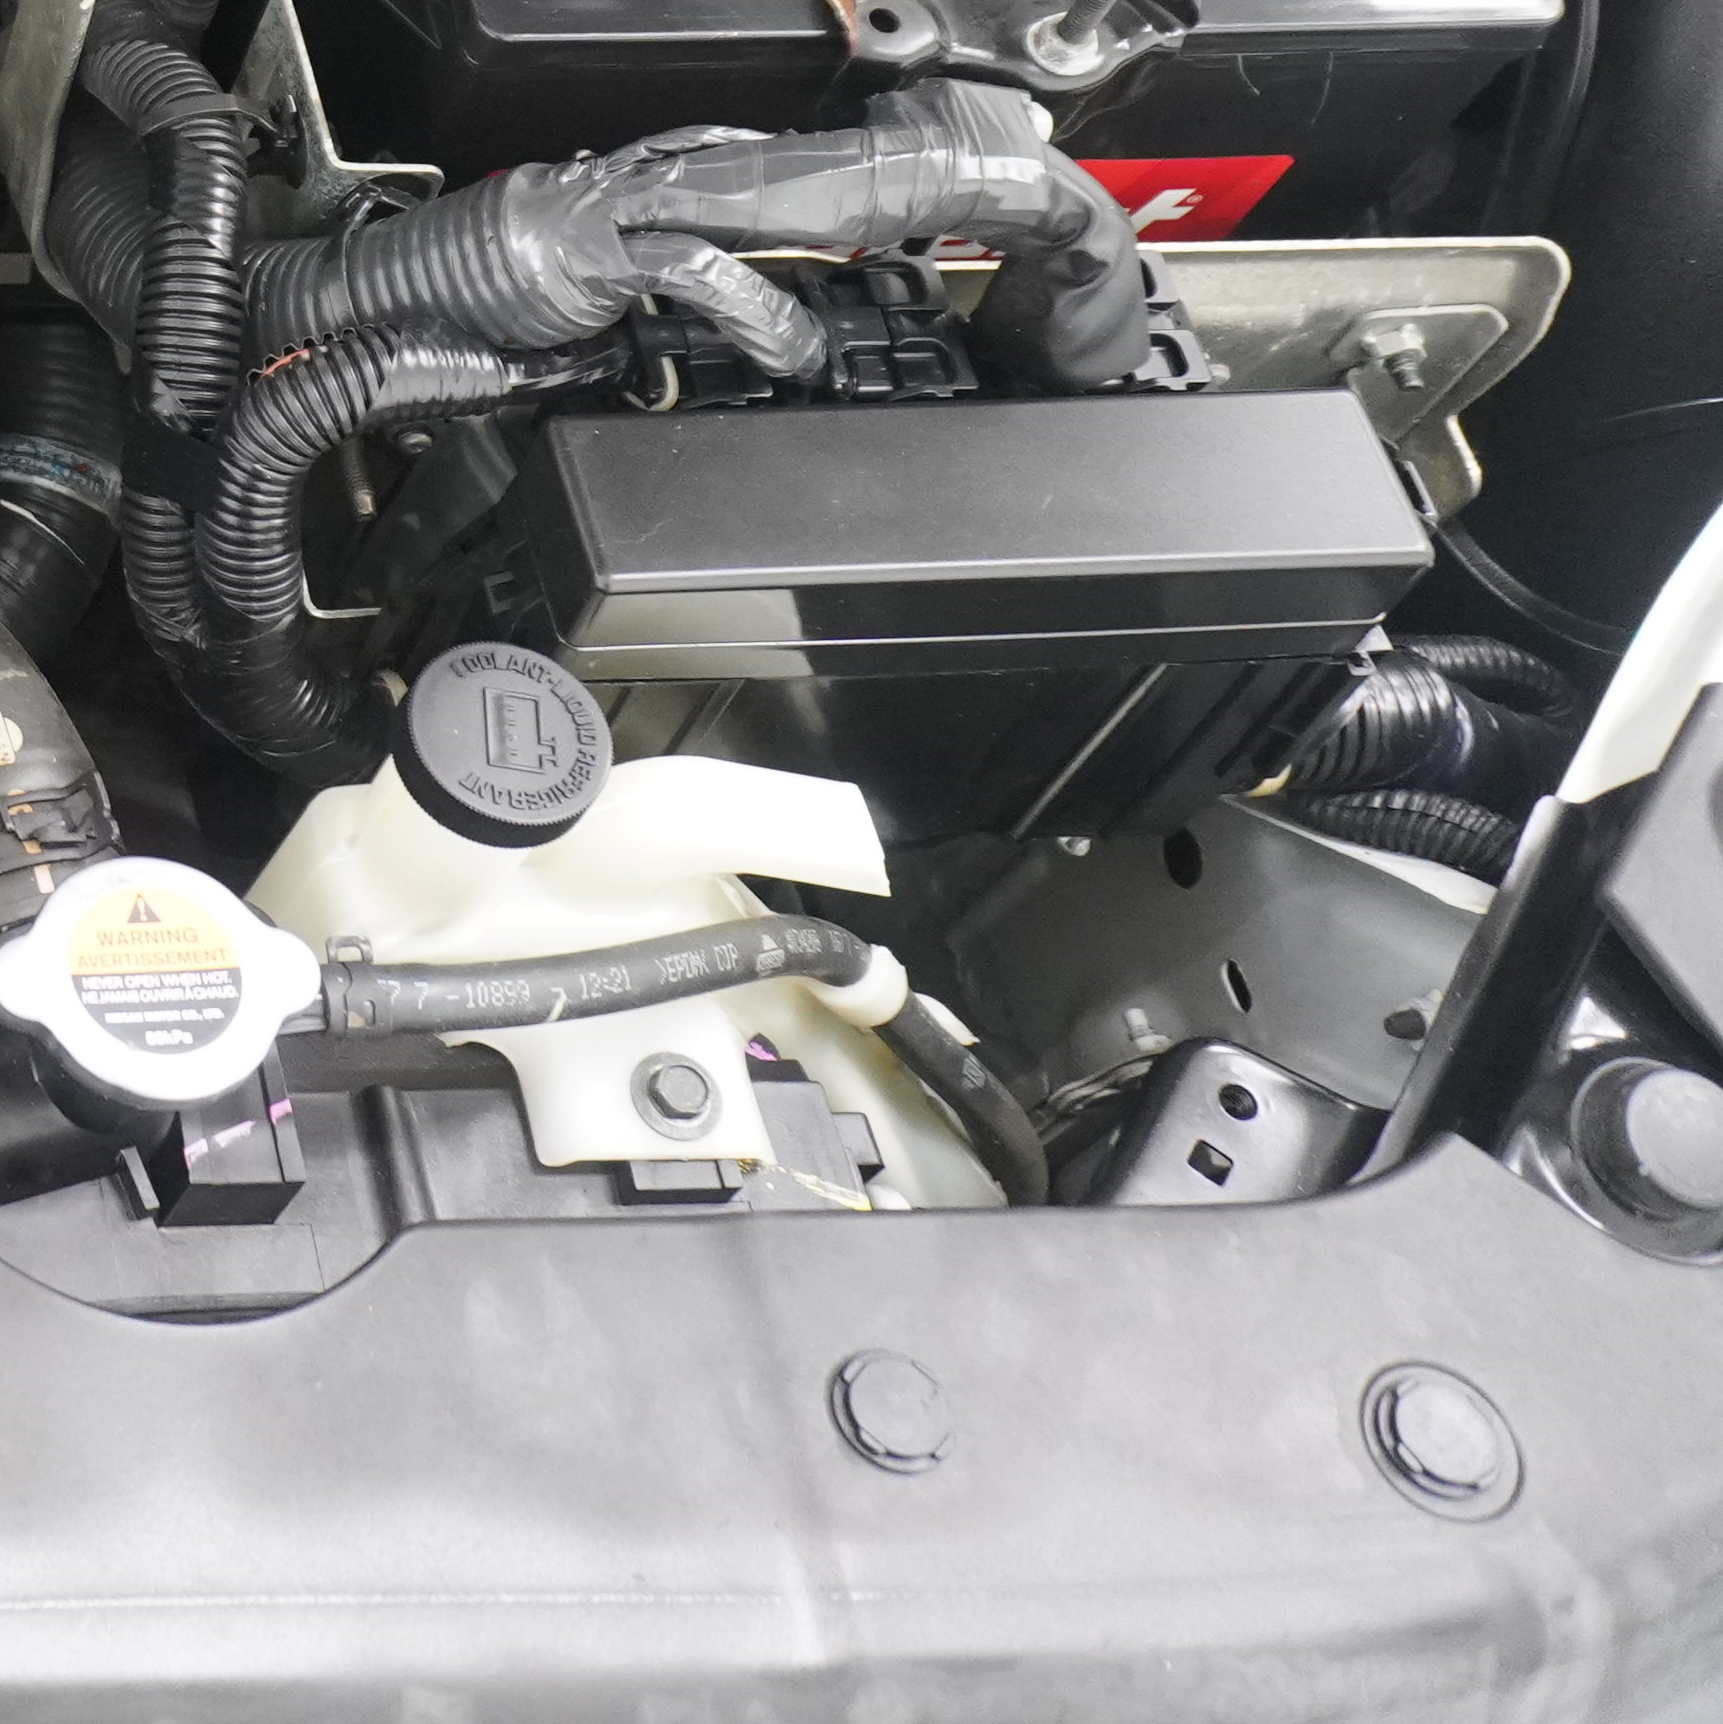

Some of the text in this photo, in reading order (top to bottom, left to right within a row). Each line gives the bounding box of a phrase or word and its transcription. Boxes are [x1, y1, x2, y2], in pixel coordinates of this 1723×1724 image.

[458, 748, 597, 812] REFRIGERANT
[97, 927, 198, 947] WARNING
[77, 948, 227, 969] AVERTISSEMENT
[82, 975, 124, 990] NEVER
[124, 974, 160, 989] OPEN
[160, 972, 201, 987] WHEN
